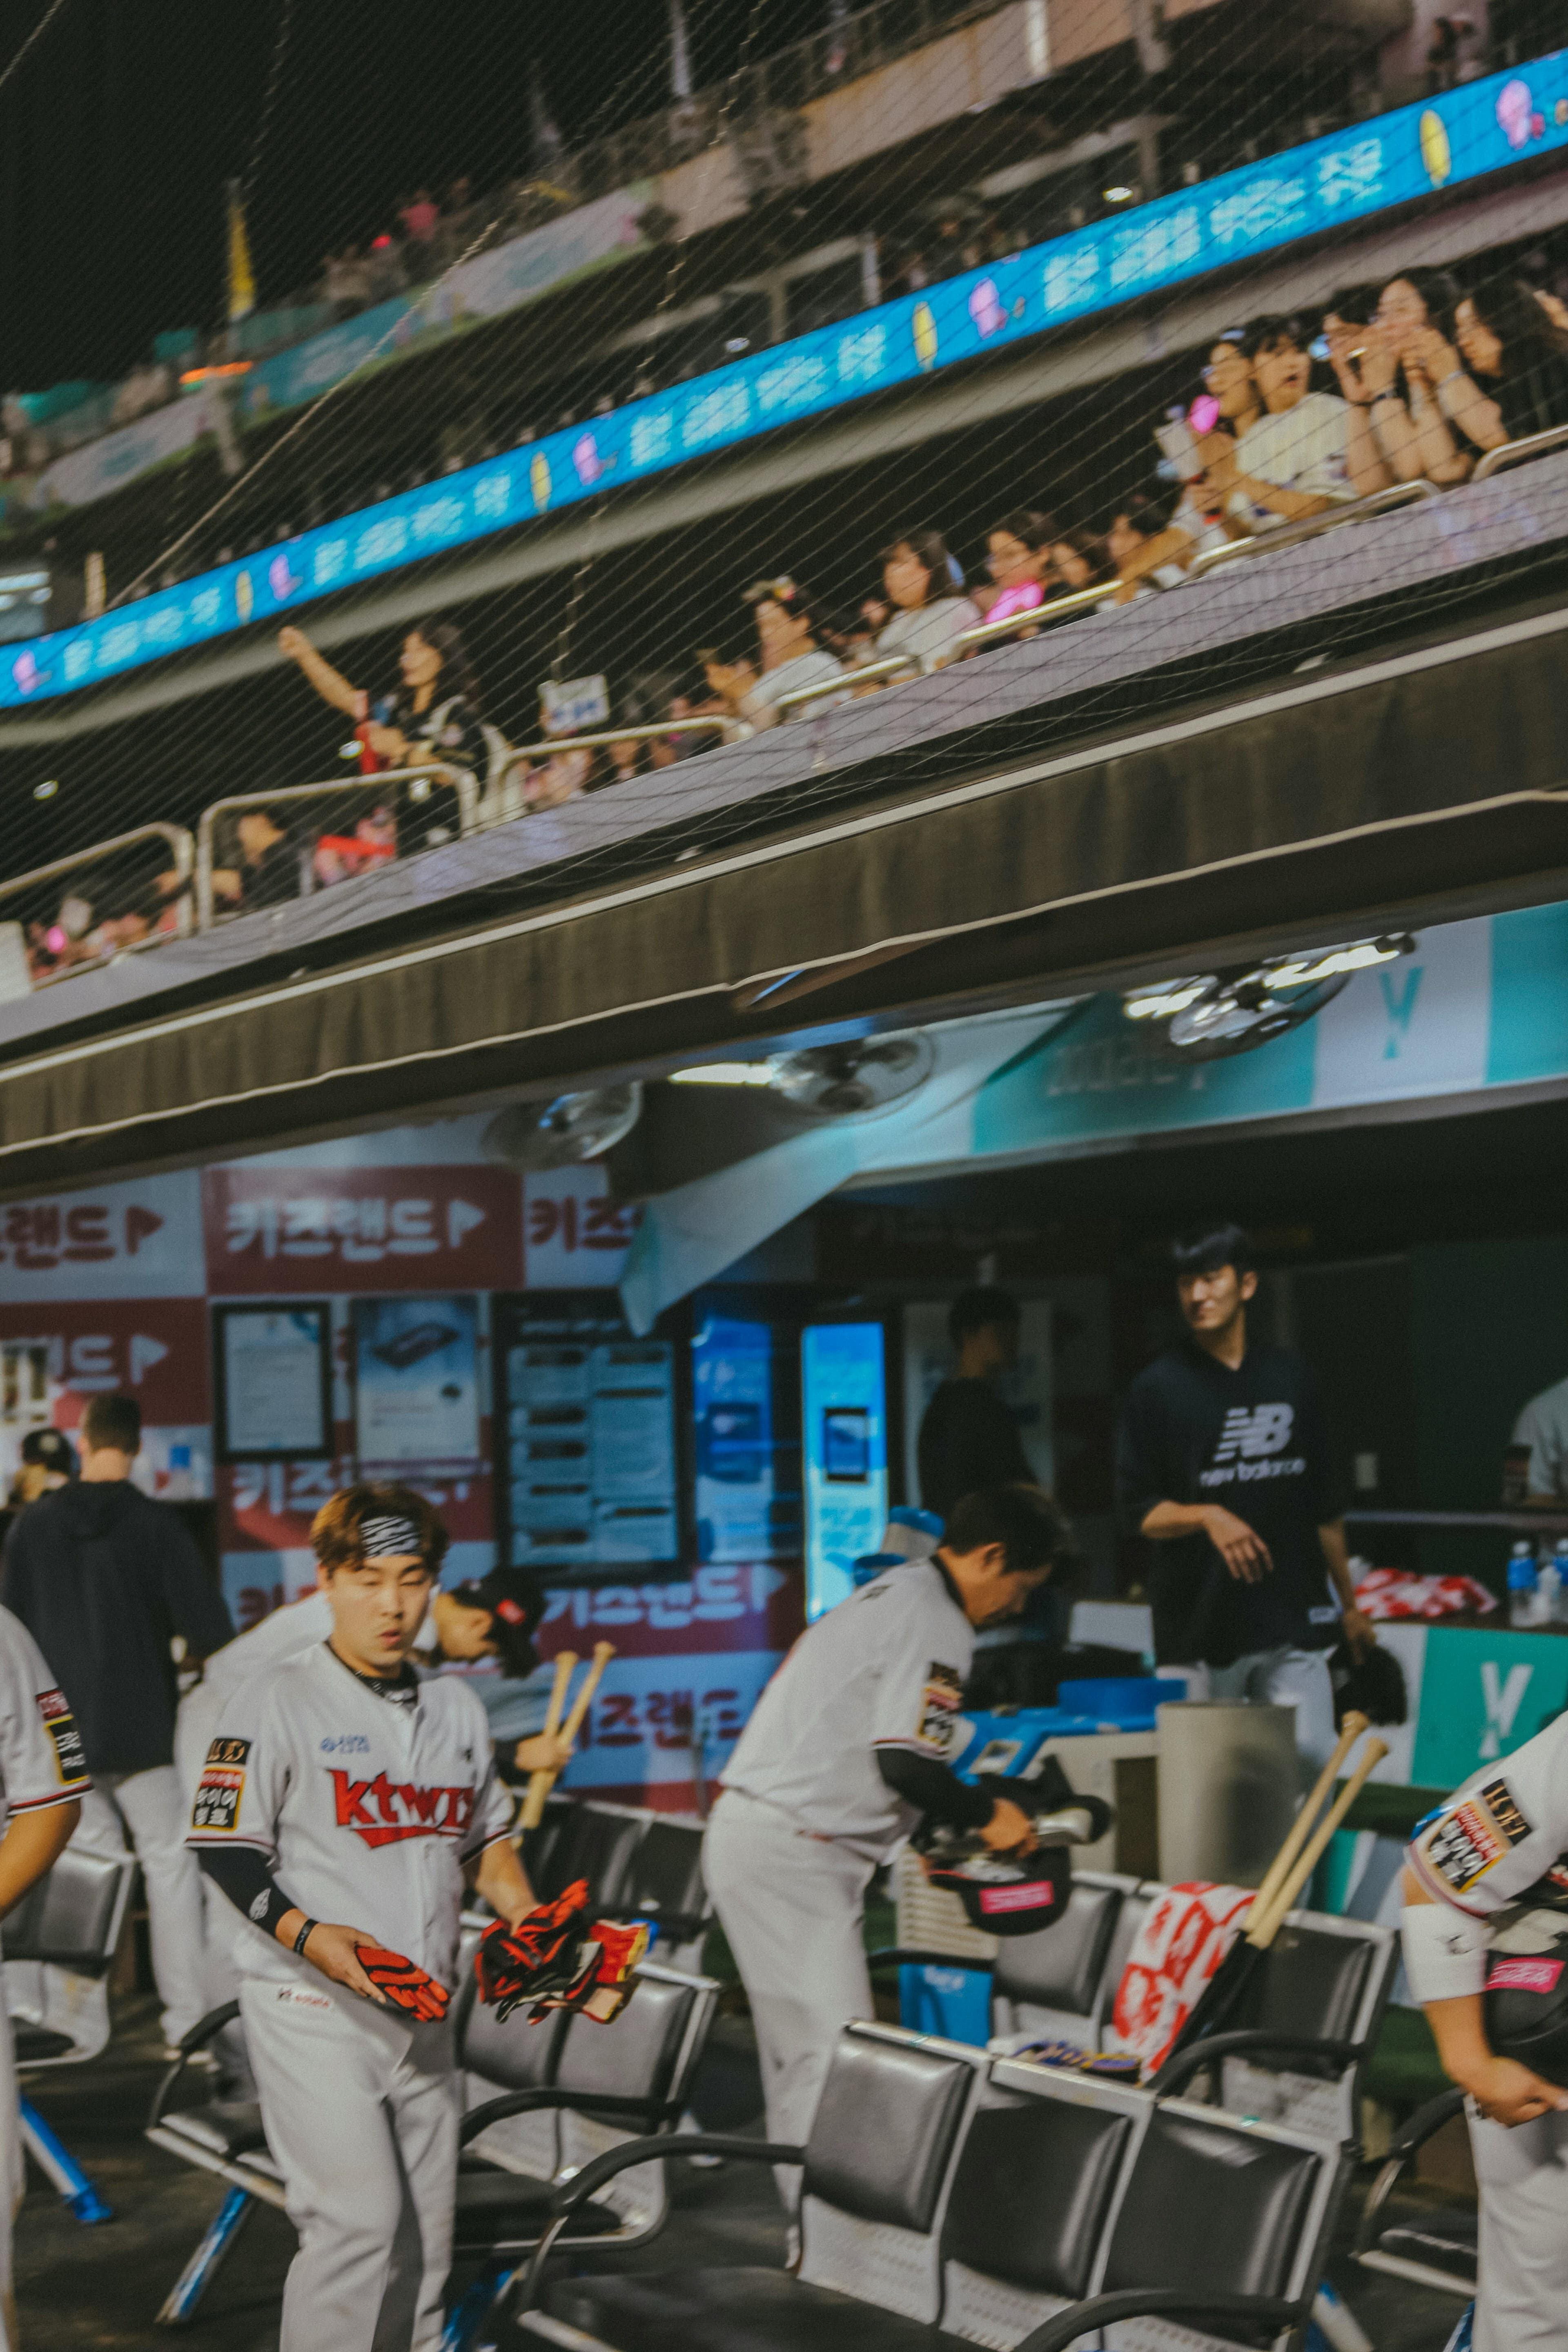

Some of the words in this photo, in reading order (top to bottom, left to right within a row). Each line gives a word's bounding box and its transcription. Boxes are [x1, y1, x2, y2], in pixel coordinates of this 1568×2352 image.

[0, 1205, 117, 1271] 랜드
[227, 1197, 440, 1262] 키즈랜드
[530, 1194, 646, 1252] 키즈
[579, 1689, 740, 1750] 즈랜드
